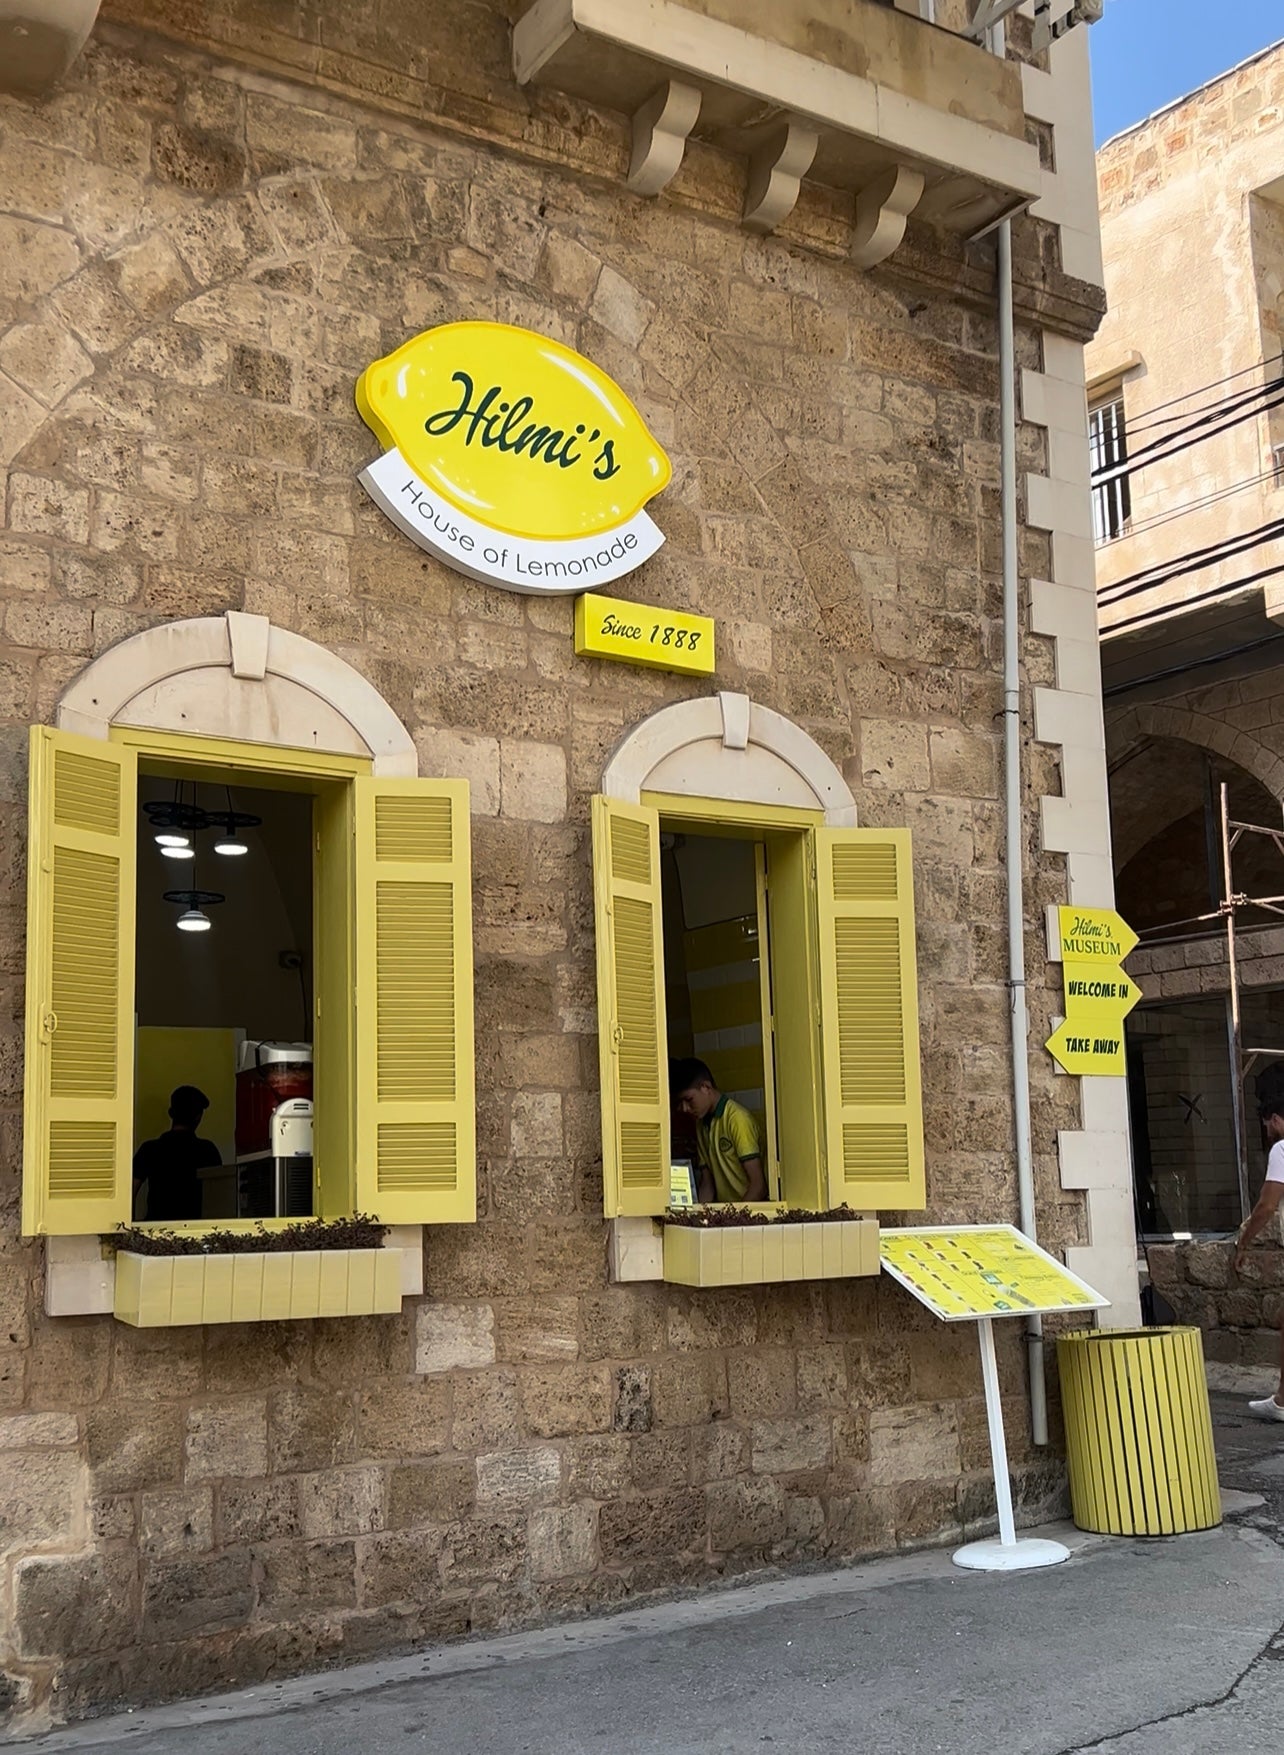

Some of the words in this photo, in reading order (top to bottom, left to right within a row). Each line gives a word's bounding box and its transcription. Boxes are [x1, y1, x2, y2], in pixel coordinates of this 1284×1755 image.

[425, 372, 620, 480] Hilmi's
[401, 481, 475, 552] House
[483, 546, 509, 568] of
[516, 531, 638, 577] Lemonade
[601, 614, 642, 639] Since
[650, 625, 702, 651] 1888
[1070, 917, 1112, 938] Hilmi's
[1063, 938, 1121, 955] MUSEUM
[1068, 980, 1116, 998] WELCOME
[1118, 984, 1129, 999] IN
[1065, 1038, 1090, 1053] TAKE
[1092, 1038, 1120, 1055] AWAY
